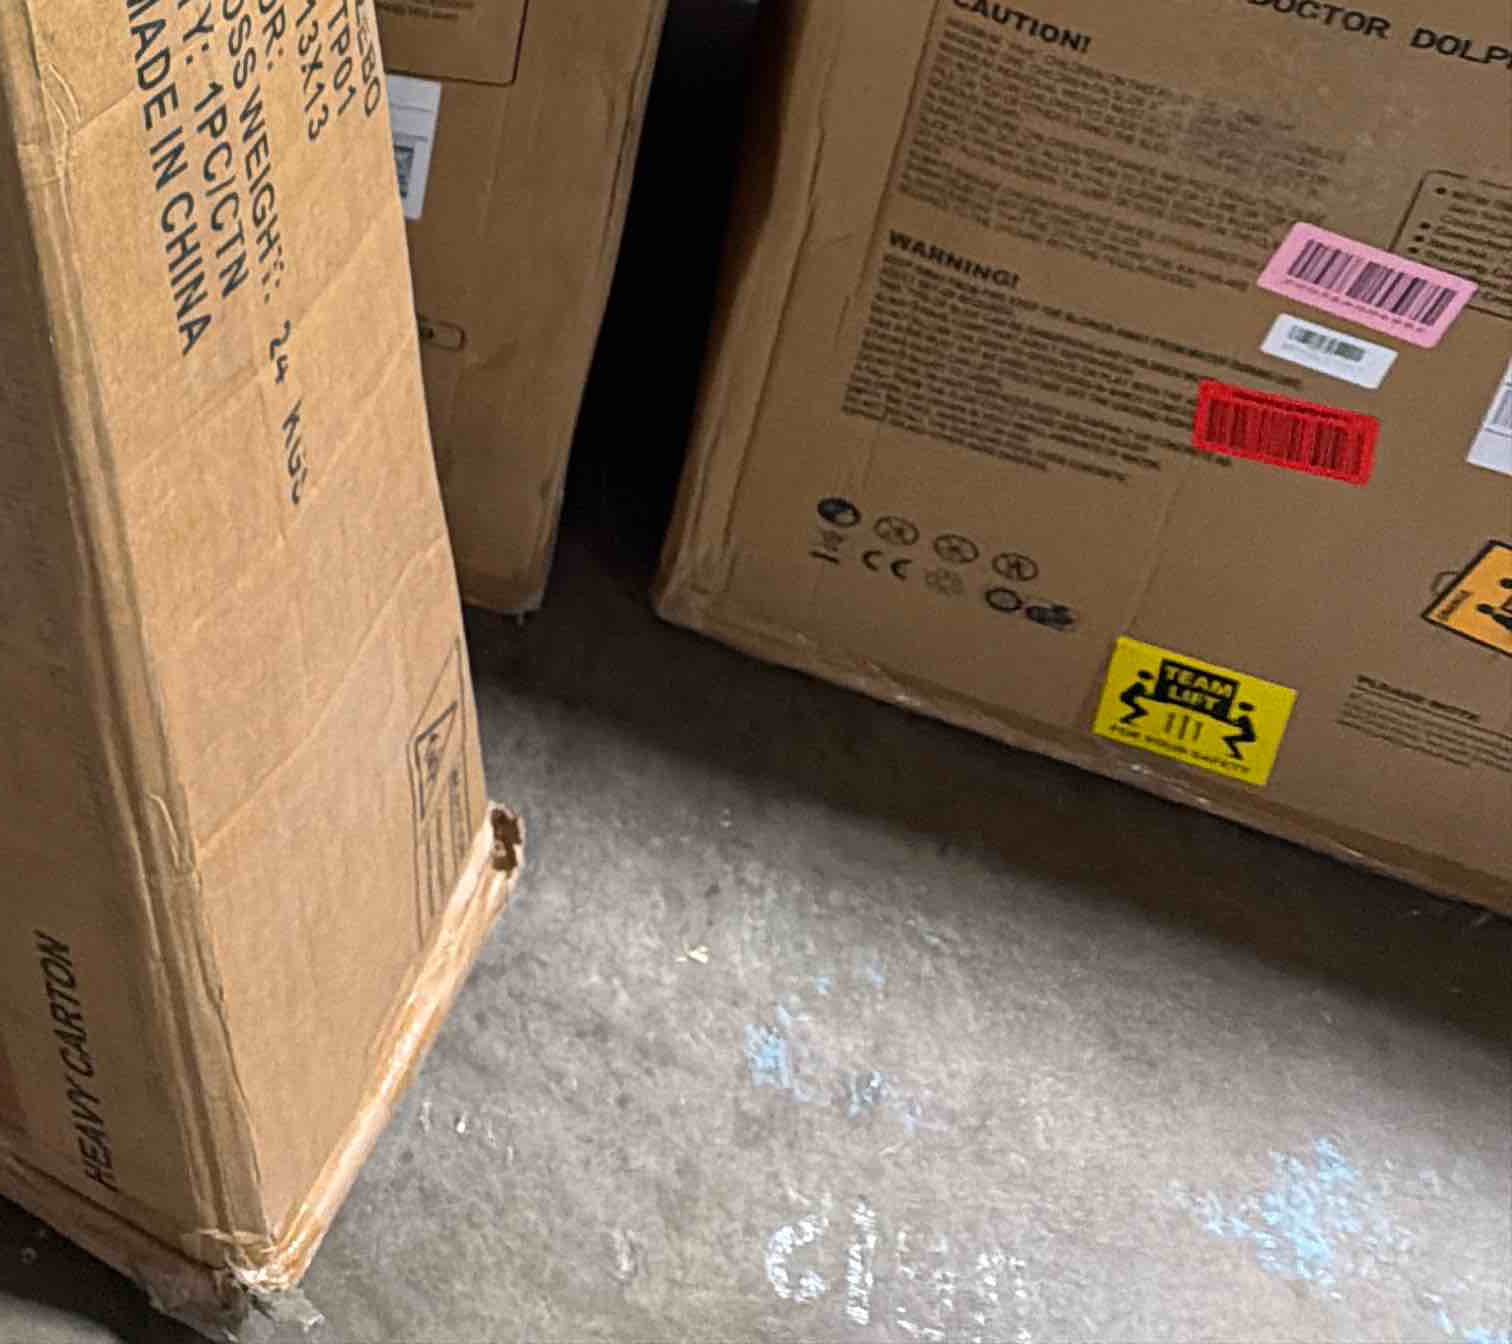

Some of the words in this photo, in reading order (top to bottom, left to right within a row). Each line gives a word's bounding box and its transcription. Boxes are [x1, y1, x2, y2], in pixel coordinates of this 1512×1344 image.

[1410, 27, 1512, 70] DOLP
[149, 126, 189, 192] IN
[160, 191, 212, 356] CHINA
[888, 229, 1020, 288] WARNING!
[269, 319, 291, 384] 24
[1164, 665, 1233, 697] TEAM
[1167, 685, 1216, 710] LIFT
[33, 929, 95, 1078] CARTON
[65, 1072, 119, 1193] HEAVY
